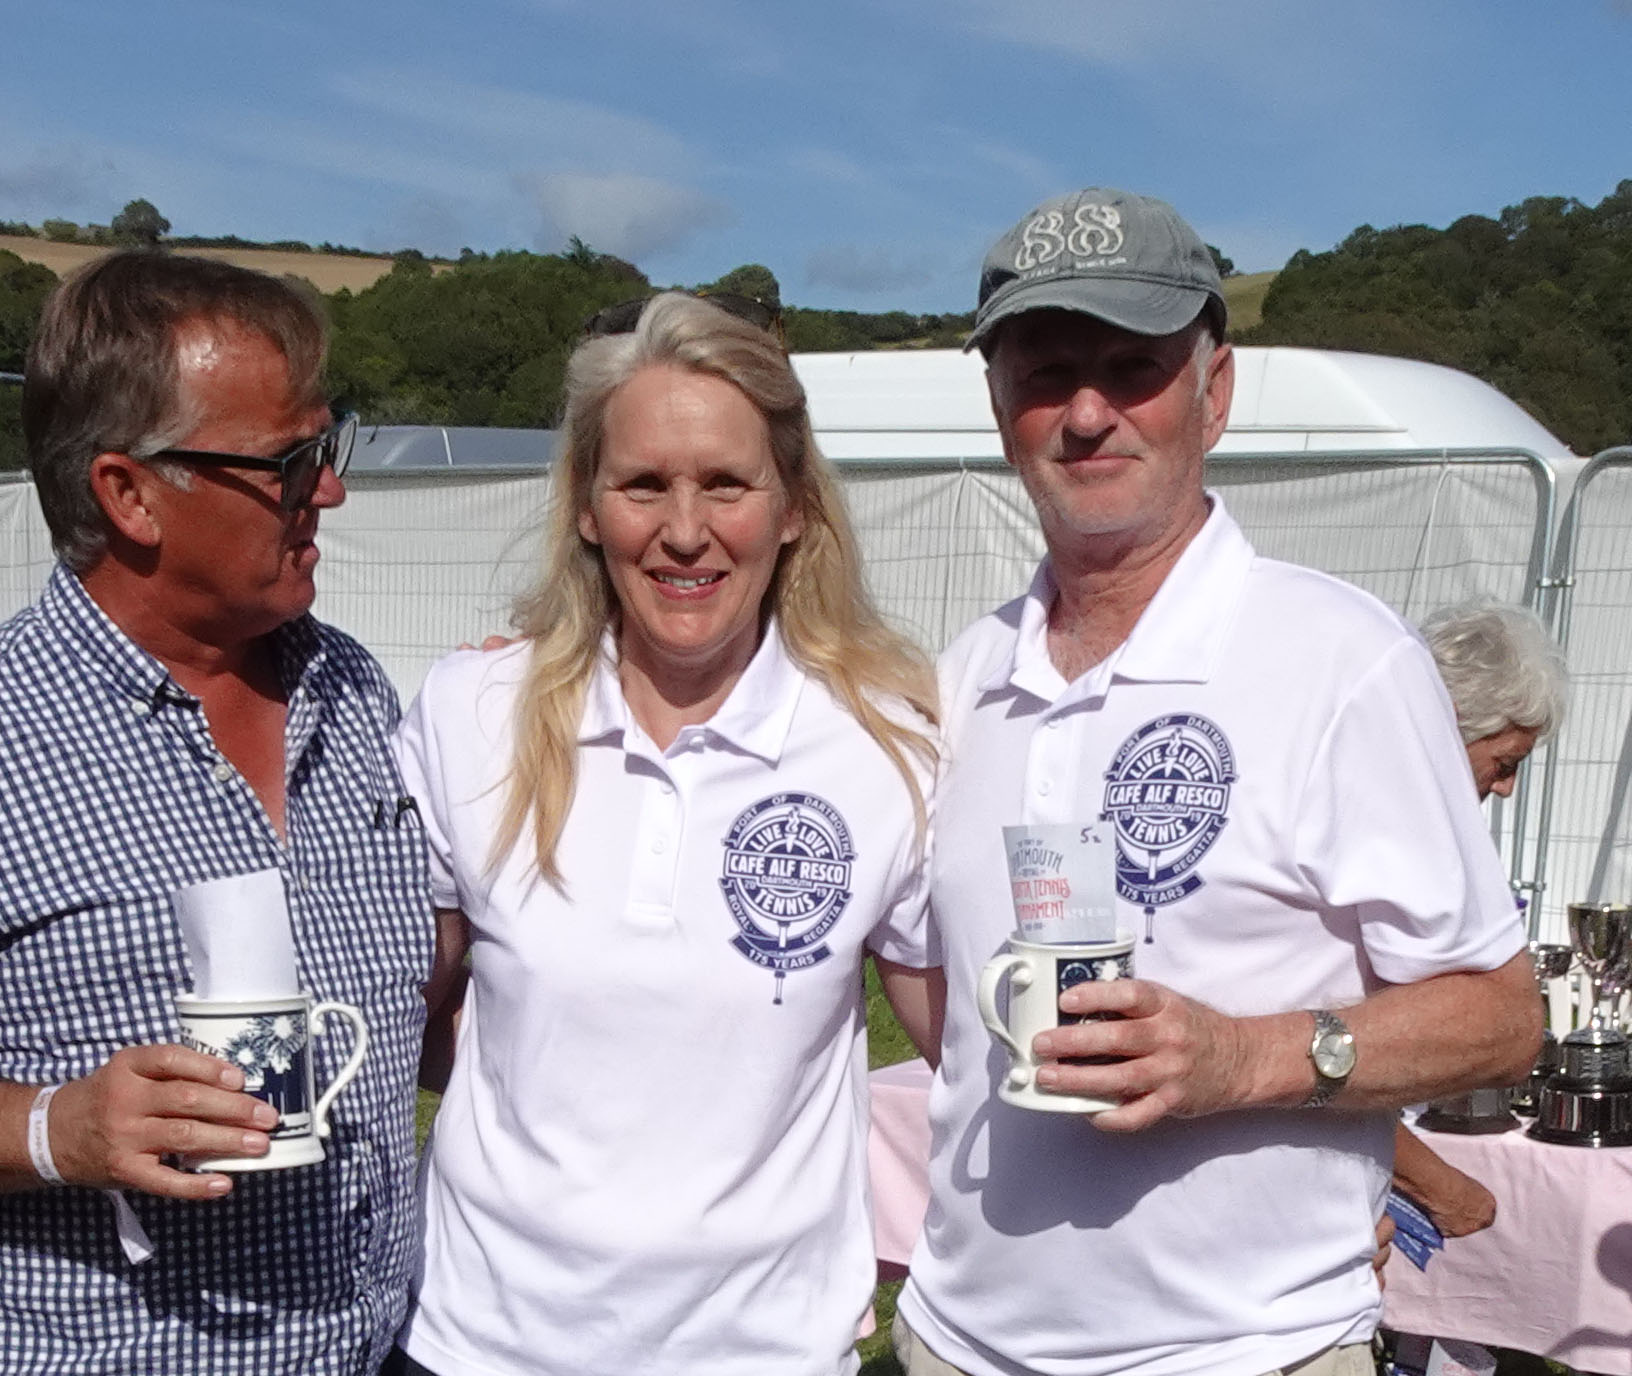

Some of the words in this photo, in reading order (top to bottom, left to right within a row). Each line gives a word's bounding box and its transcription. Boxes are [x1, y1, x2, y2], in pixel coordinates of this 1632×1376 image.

[1117, 733, 1140, 763] PORT
[1155, 716, 1172, 729] OF
[1186, 716, 1233, 773] DARTMOUTH
[1129, 748, 1163, 778] LIVE
[1179, 748, 1210, 780] LOVE
[1144, 785, 1173, 804] ALF
[1175, 786, 1223, 809] RESCO
[734, 808, 759, 834] PORT
[771, 796, 788, 806] OF
[803, 796, 852, 852] DARTMOUTH
[1128, 817, 1188, 843] TENNIS
[749, 824, 783, 852] LIVE
[798, 825, 831, 858] LOVE
[1172, 831, 1216, 875] REGATTA
[769, 858, 796, 877] ALF
[799, 861, 845, 884] RESCO
[755, 889, 816, 915] TENNIS
[1120, 884, 1139, 901] 175
[1143, 886, 1186, 903] YEARS
[728, 894, 750, 930] ROYAL
[802, 905, 842, 944] REGATTA
[749, 948, 768, 965] 175
[773, 953, 815, 969] YEARS
